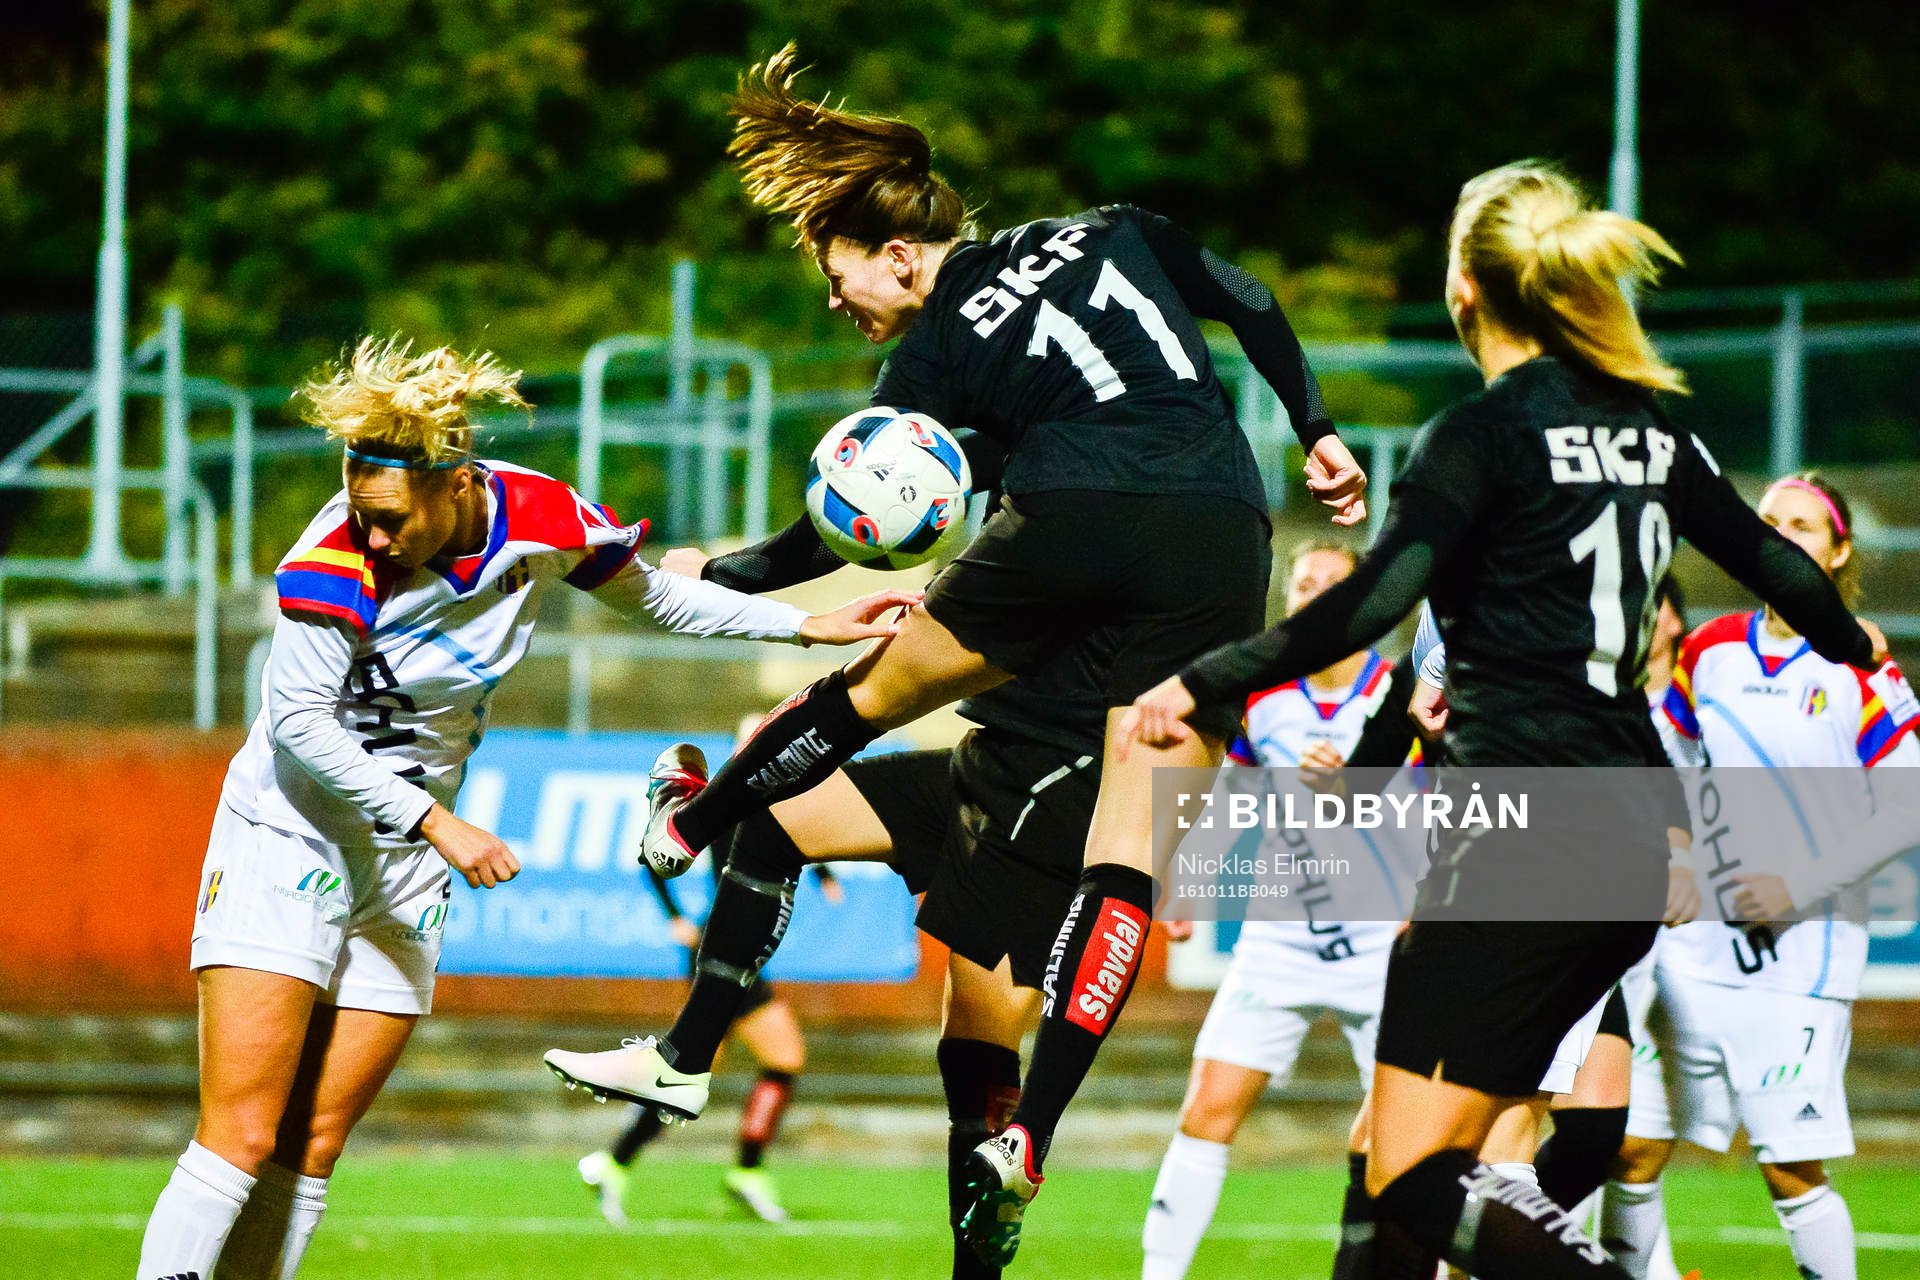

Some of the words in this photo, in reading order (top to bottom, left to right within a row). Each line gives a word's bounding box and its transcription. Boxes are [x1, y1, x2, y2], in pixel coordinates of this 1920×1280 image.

[958, 222, 1091, 340] SKF
[1026, 257, 1198, 403] 11
[1544, 425, 1676, 486] SKF
[1078, 909, 1142, 1023] Stavdal
[1802, 1027, 1815, 1055] 7
